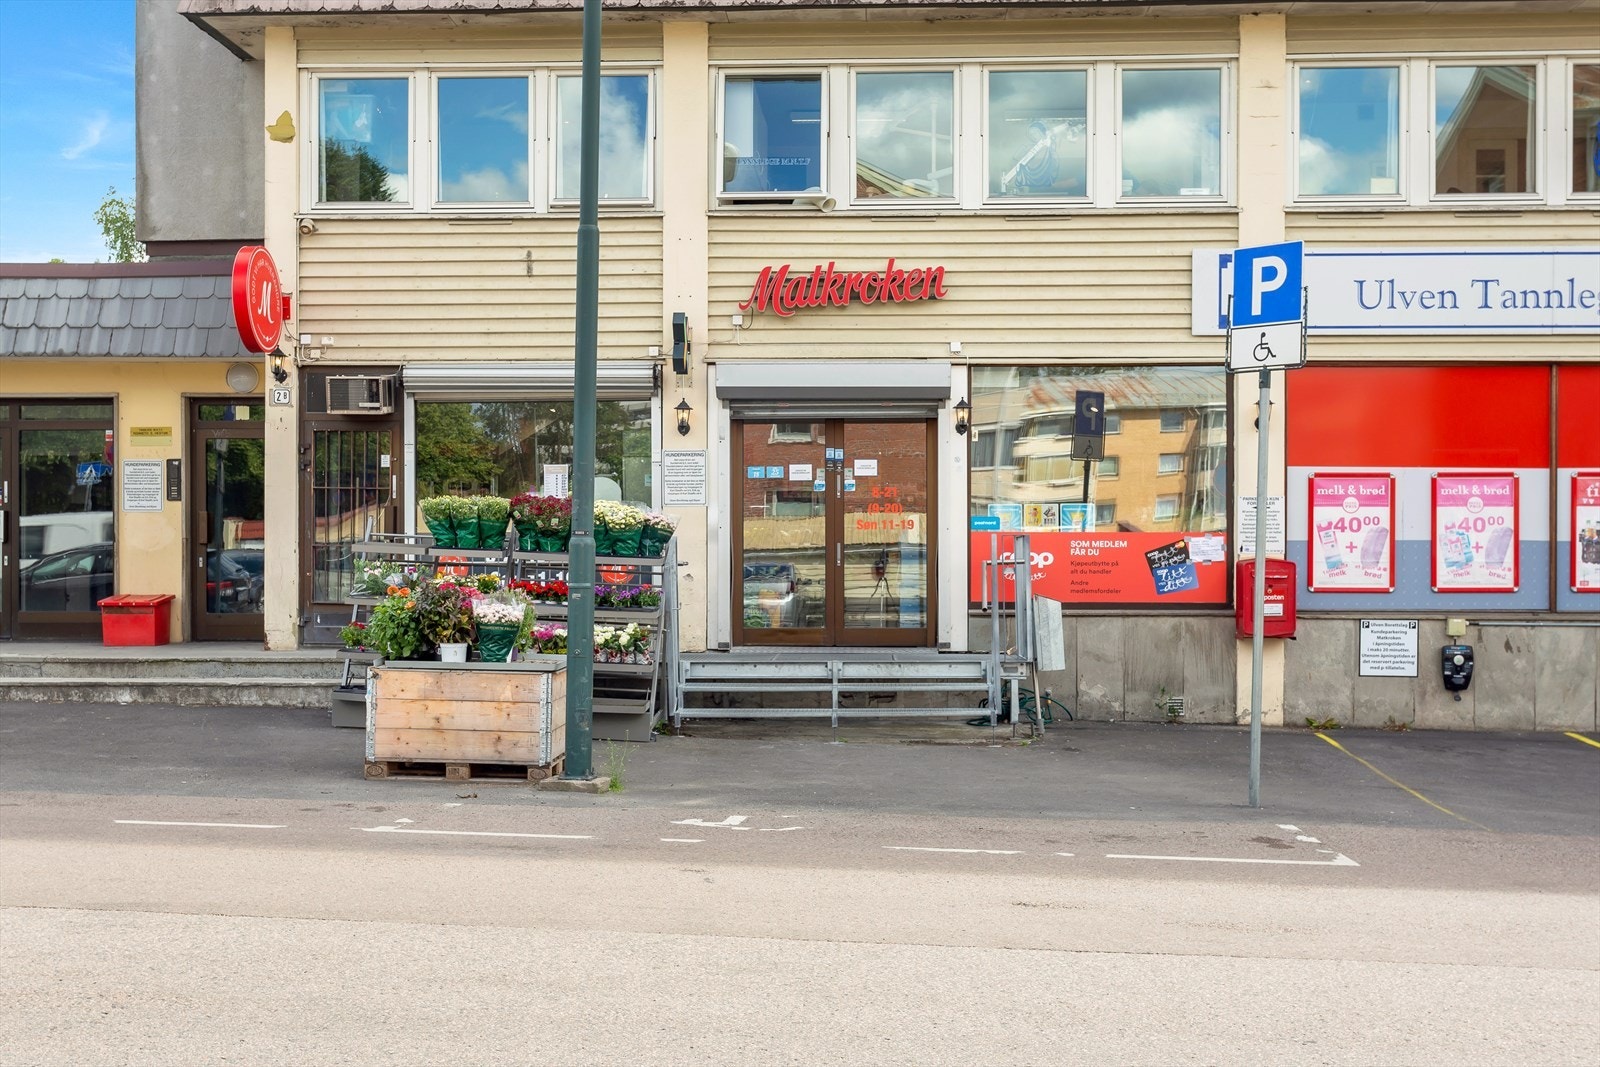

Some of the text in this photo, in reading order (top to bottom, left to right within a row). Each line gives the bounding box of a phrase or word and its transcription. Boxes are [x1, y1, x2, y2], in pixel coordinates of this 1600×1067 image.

[738, 258, 948, 317] Matkroken
[1251, 256, 1288, 316] P
[258, 280, 274, 324] M
[1353, 278, 1600, 316] Ulven Tannle
[276, 392, 282, 402] 2
[872, 486, 897, 498] 8-21
[1317, 485, 1386, 495] melk & brød
[1441, 485, 1510, 495] melk & brød
[868, 503, 903, 516] (9-20)
[856, 520, 914, 530] Søn 11-19
[1070, 547, 1086, 556] FÅR
